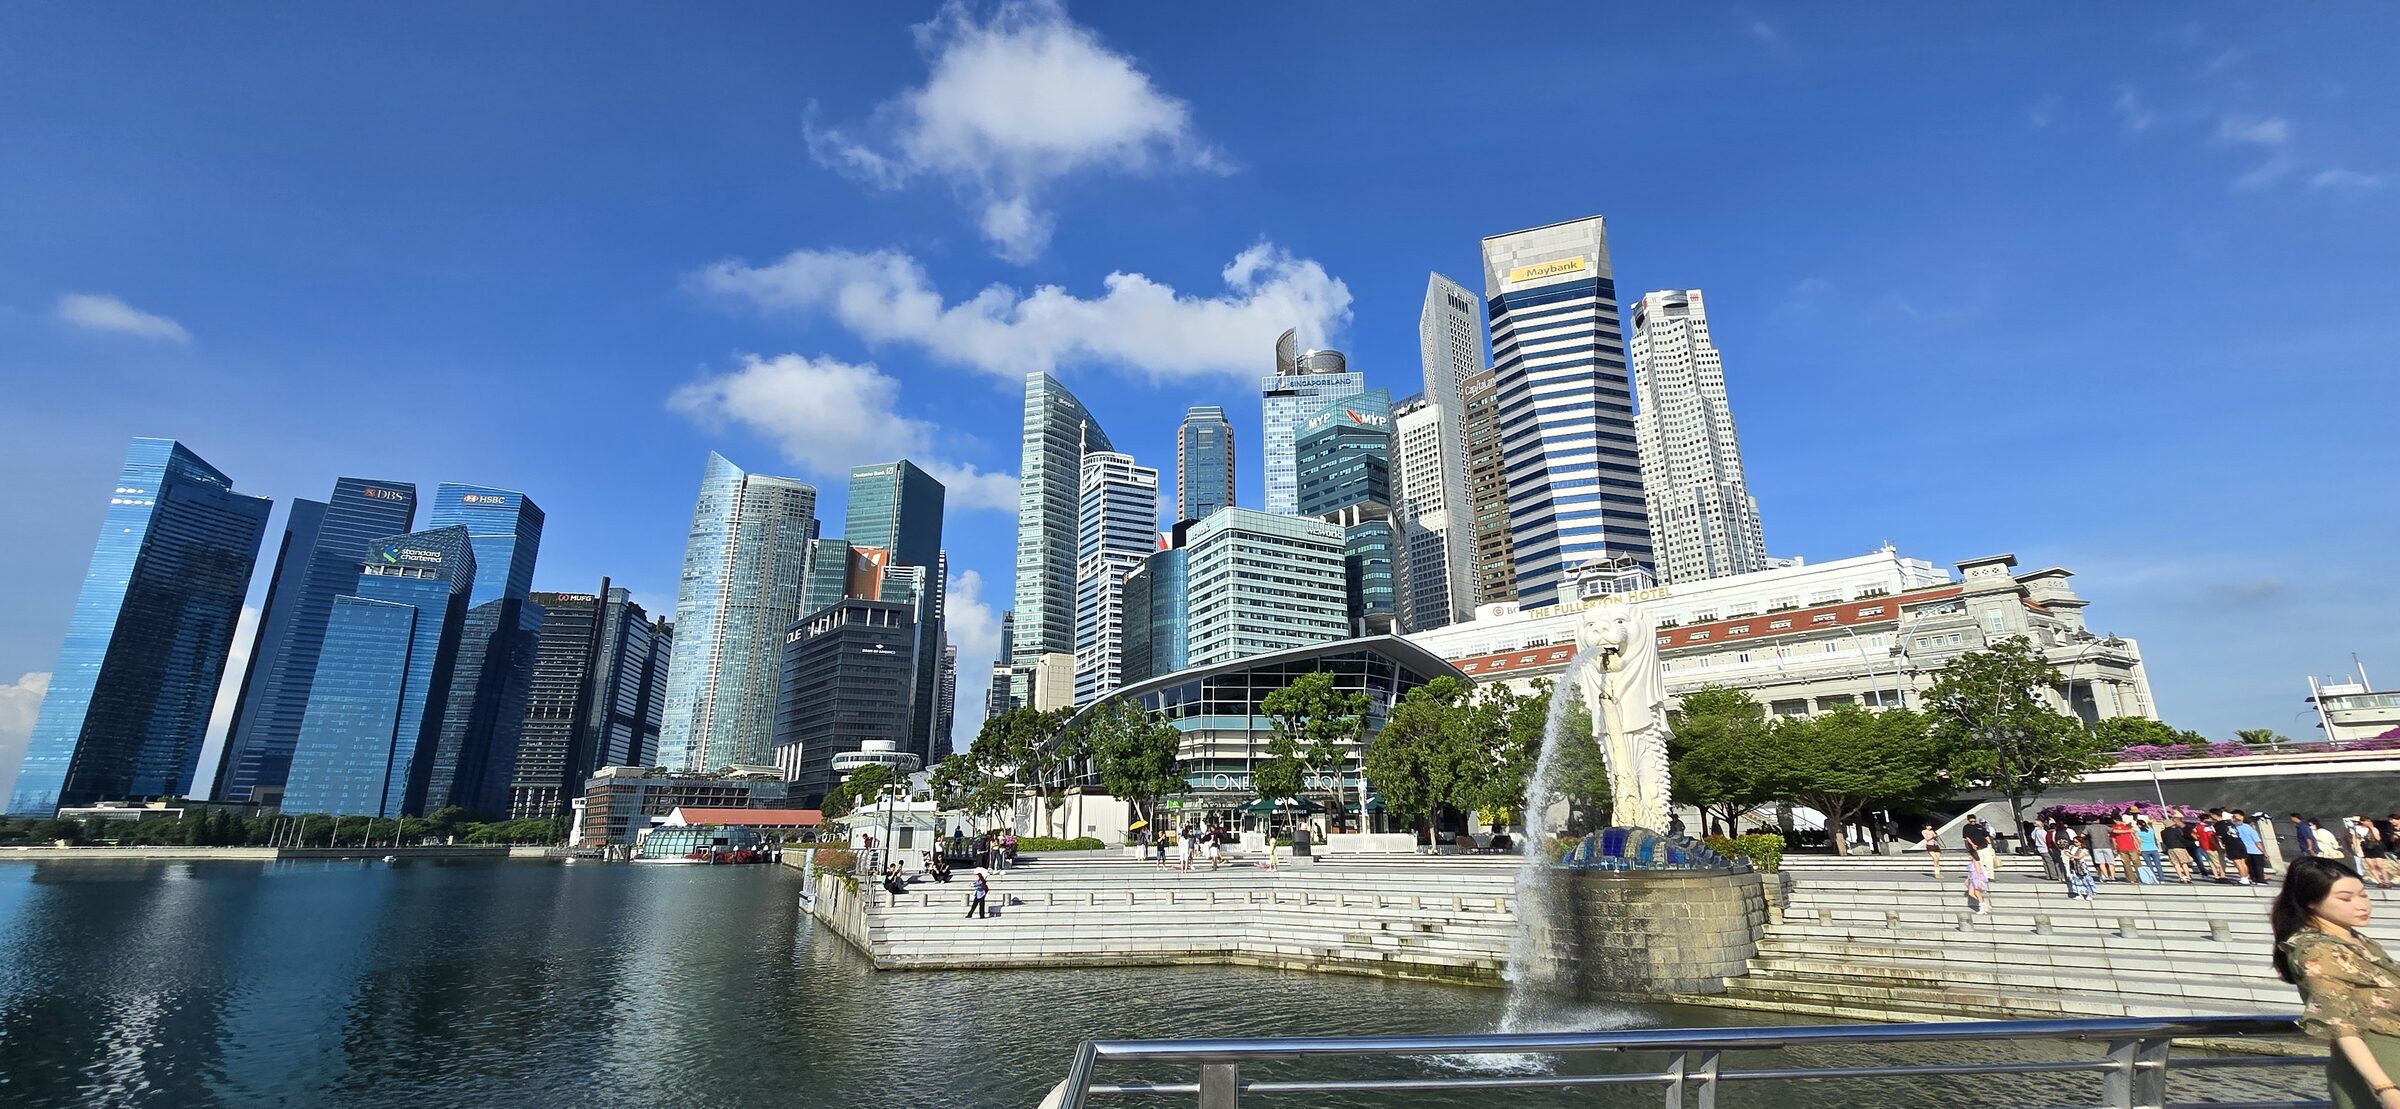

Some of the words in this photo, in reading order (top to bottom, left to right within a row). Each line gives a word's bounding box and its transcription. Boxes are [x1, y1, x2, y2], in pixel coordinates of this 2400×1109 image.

[1526, 261, 1577, 277] Maybank
[1289, 378, 1352, 388] SINGAPORELAND
[1465, 377, 1496, 395] CapitaLan
[1308, 413, 1331, 429] MYP
[1361, 412, 1387, 426] MYP
[377, 489, 404, 501] DBS
[479, 495, 506, 504] HSBC
[400, 554, 442, 563] chartered
[402, 549, 441, 558] standard
[570, 594, 592, 602] MUFG
[1527, 607, 1550, 619] THE
[1554, 595, 1623, 615] FULLERTON
[1628, 587, 1672, 602] HOTEL
[786, 628, 802, 644] OUE
[1213, 773, 1250, 791] ONE
